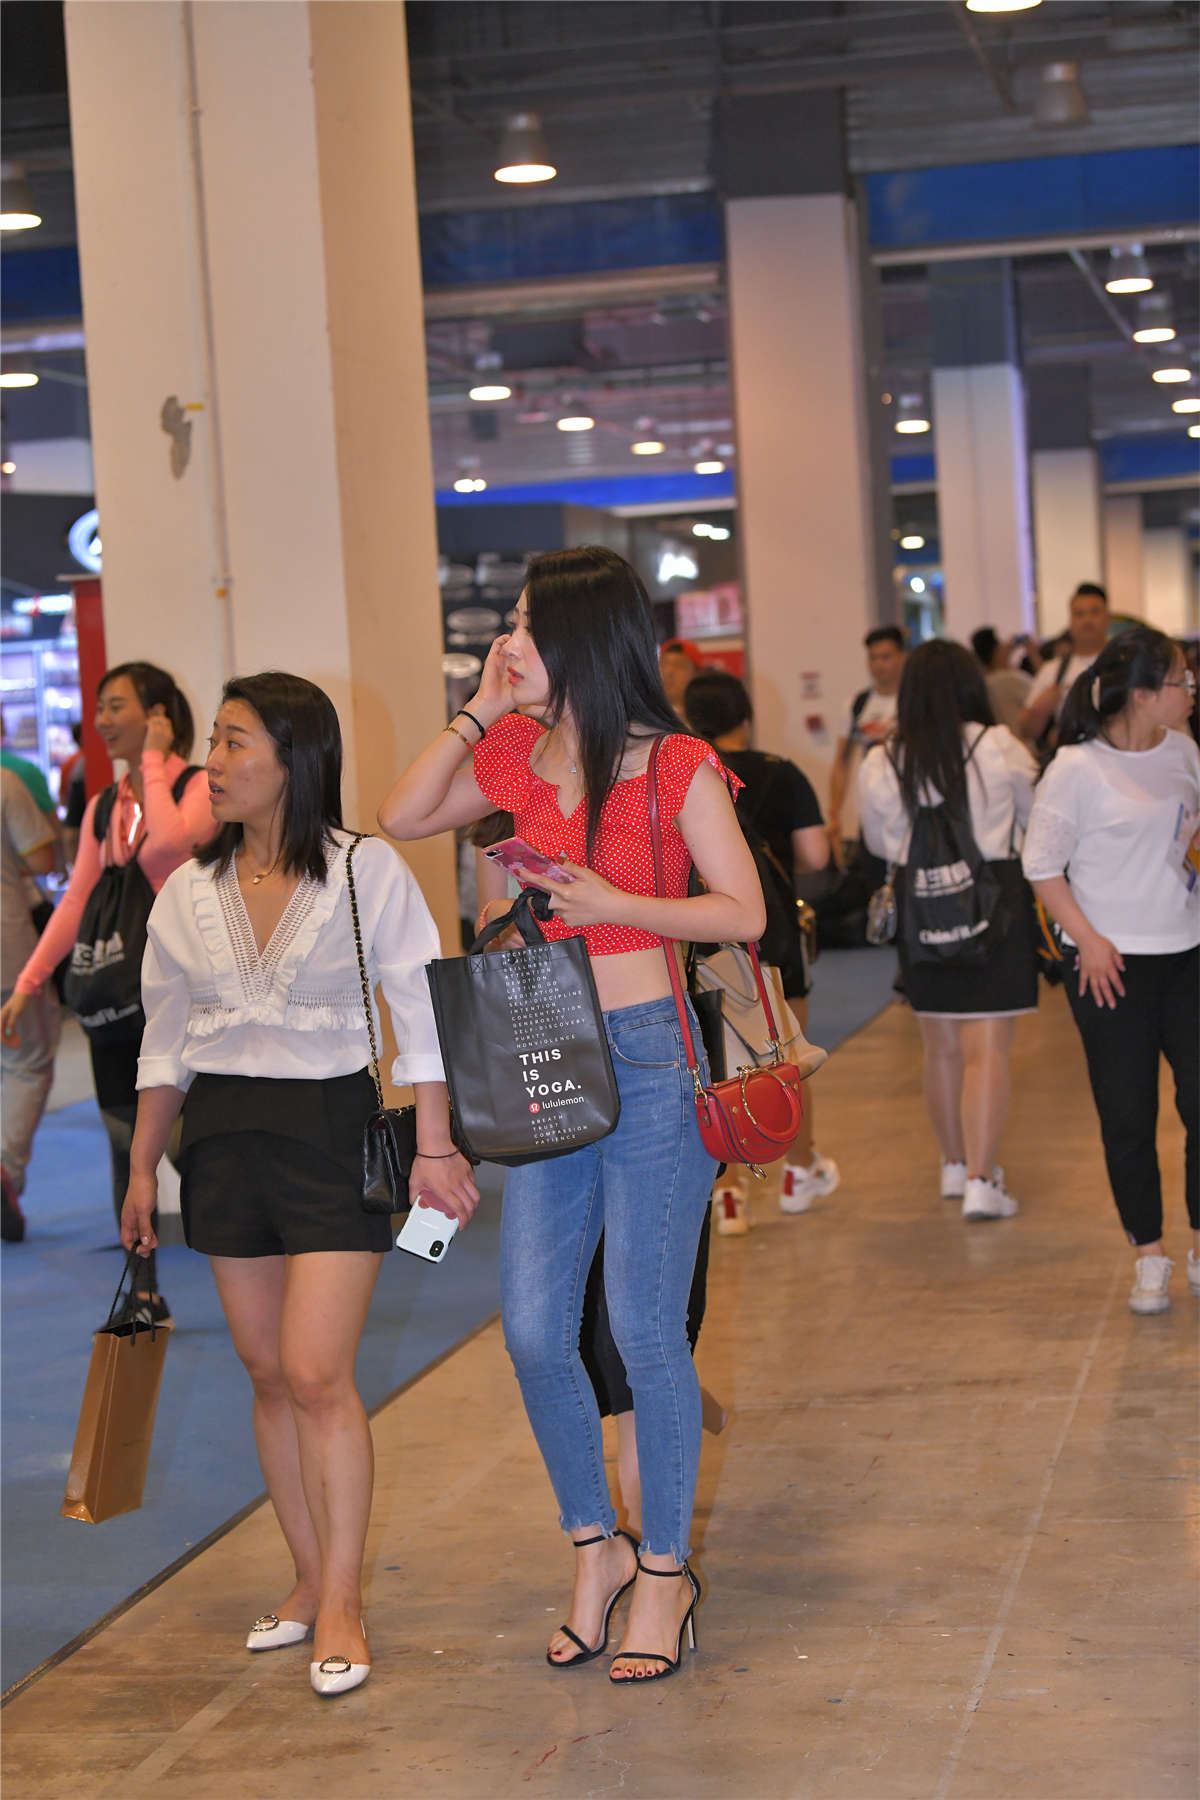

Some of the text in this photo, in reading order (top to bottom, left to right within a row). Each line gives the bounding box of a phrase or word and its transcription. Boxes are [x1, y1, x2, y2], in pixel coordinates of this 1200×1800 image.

[505, 968, 551, 979] ATTENTION
[505, 976, 547, 986] DEVOTION
[507, 984, 542, 994] LETTING
[508, 988, 559, 1000] MEDITATION
[510, 1002, 556, 1014] INTENTION
[511, 1005, 582, 1021] CONCENTRATION
[512, 1015, 565, 1028] GENEROSITY
[515, 1033, 545, 1042] PURITY
[516, 1034, 576, 1049] NONVIOLENCE
[519, 1048, 562, 1066] THIS
[522, 1069, 540, 1082] IS
[525, 1079, 582, 1098] YOGA.
[542, 1096, 585, 1110] lululemon
[532, 1122, 558, 1131] TRUST
[534, 1125, 588, 1139] COMPASSION
[535, 1134, 576, 1145] PATIENCE
